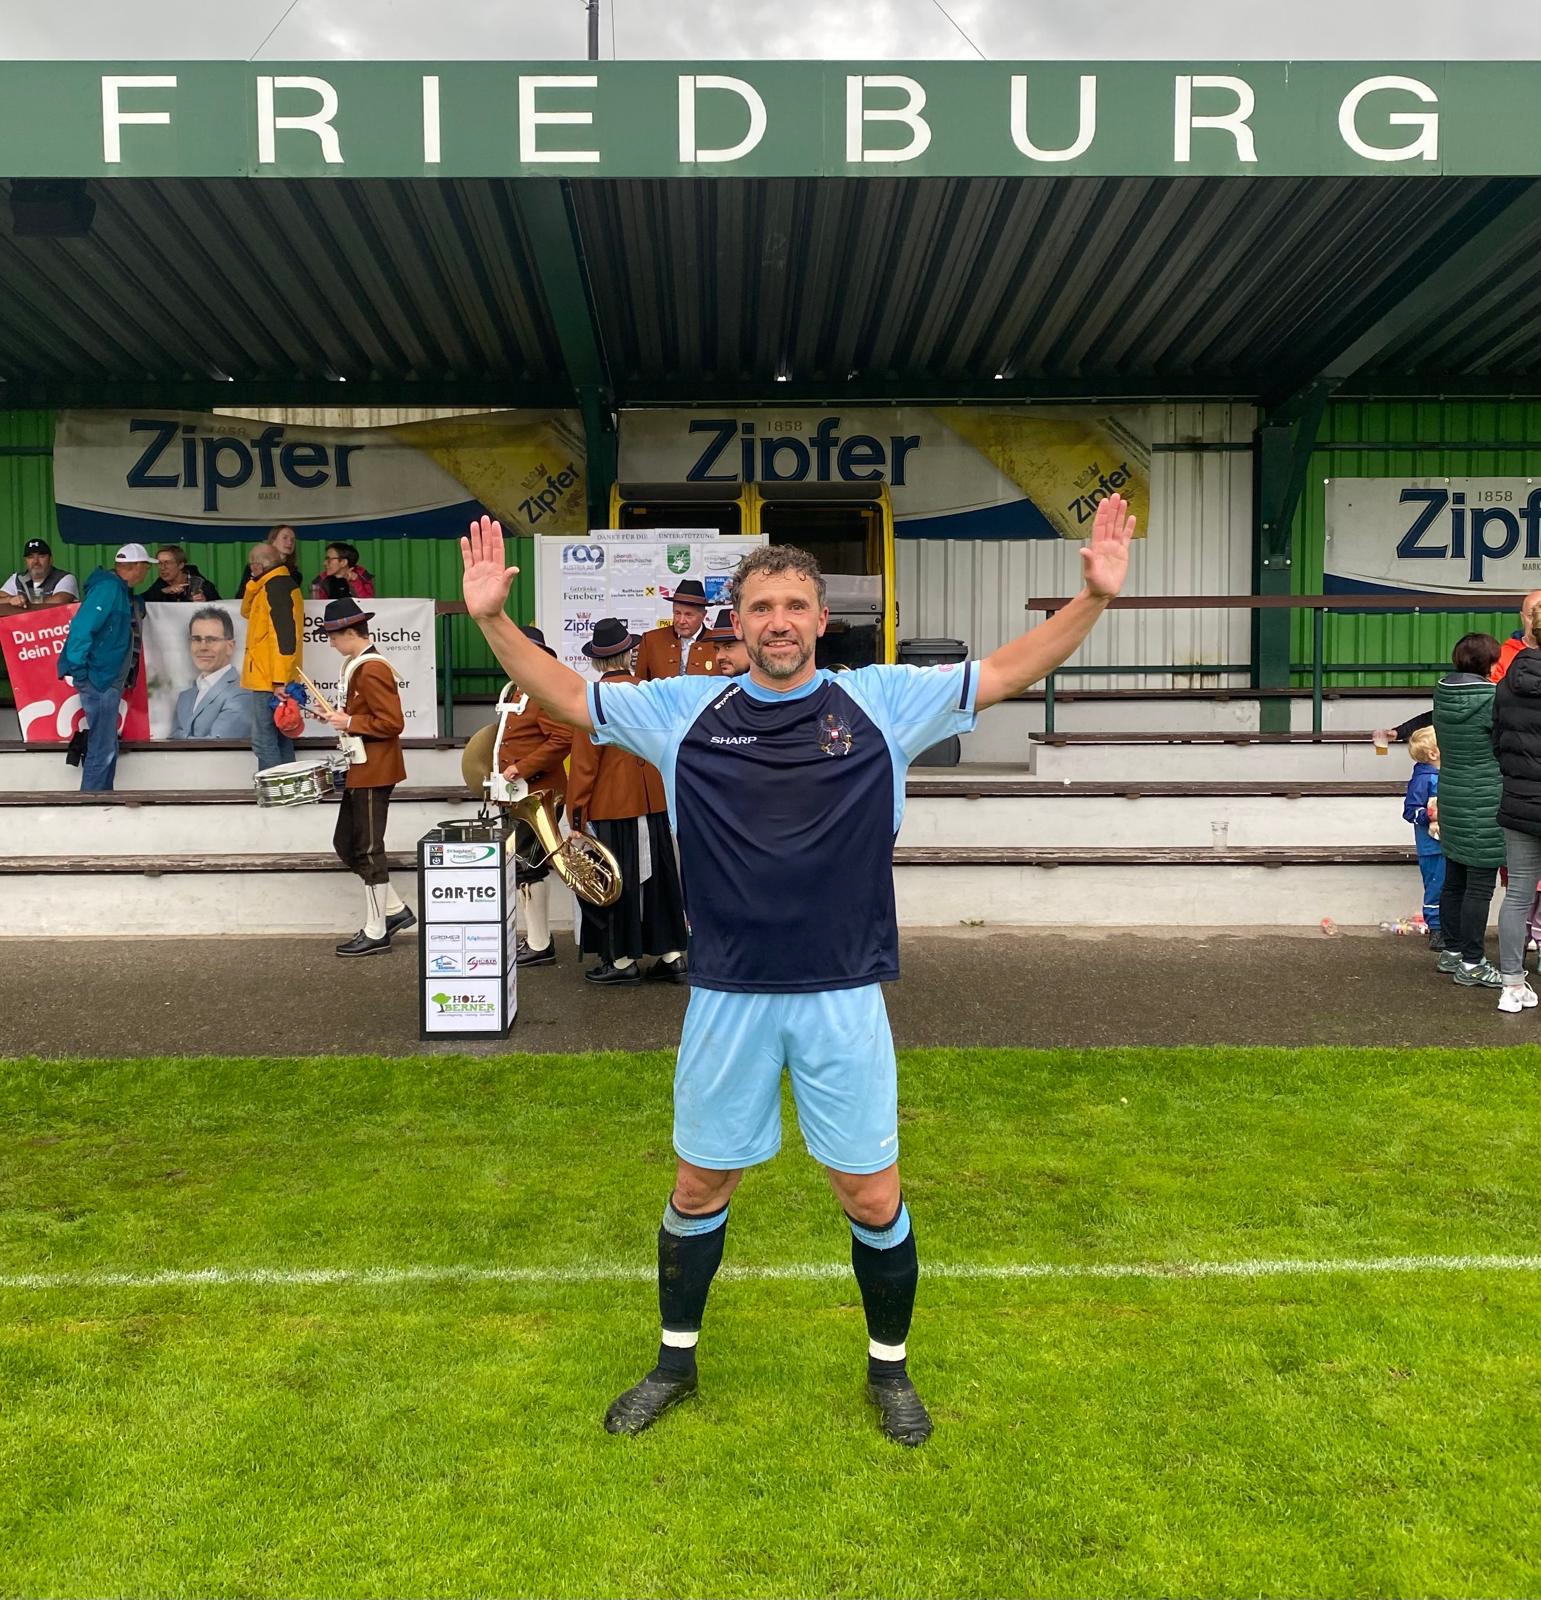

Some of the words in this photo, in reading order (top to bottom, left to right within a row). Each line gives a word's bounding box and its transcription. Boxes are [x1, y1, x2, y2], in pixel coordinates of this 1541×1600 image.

[102, 74, 1439, 163] FRIEDBURG
[768, 420, 802, 431] 1858
[686, 417, 921, 486] Zipfer
[126, 418, 366, 512] Zipfer
[518, 462, 580, 524] Zipfer
[1478, 491, 1513, 502] 1858
[1396, 487, 1541, 583] Zipf
[563, 592, 605, 601] Feneberg
[12, 630, 35, 645] Du
[38, 622, 71, 640] mac
[564, 619, 596, 633] Zipfe
[18, 644, 51, 661] dein
[710, 736, 757, 745] SHARP
[432, 886, 496, 903] CAR-TEC
[444, 1003, 495, 1012] BERNER
